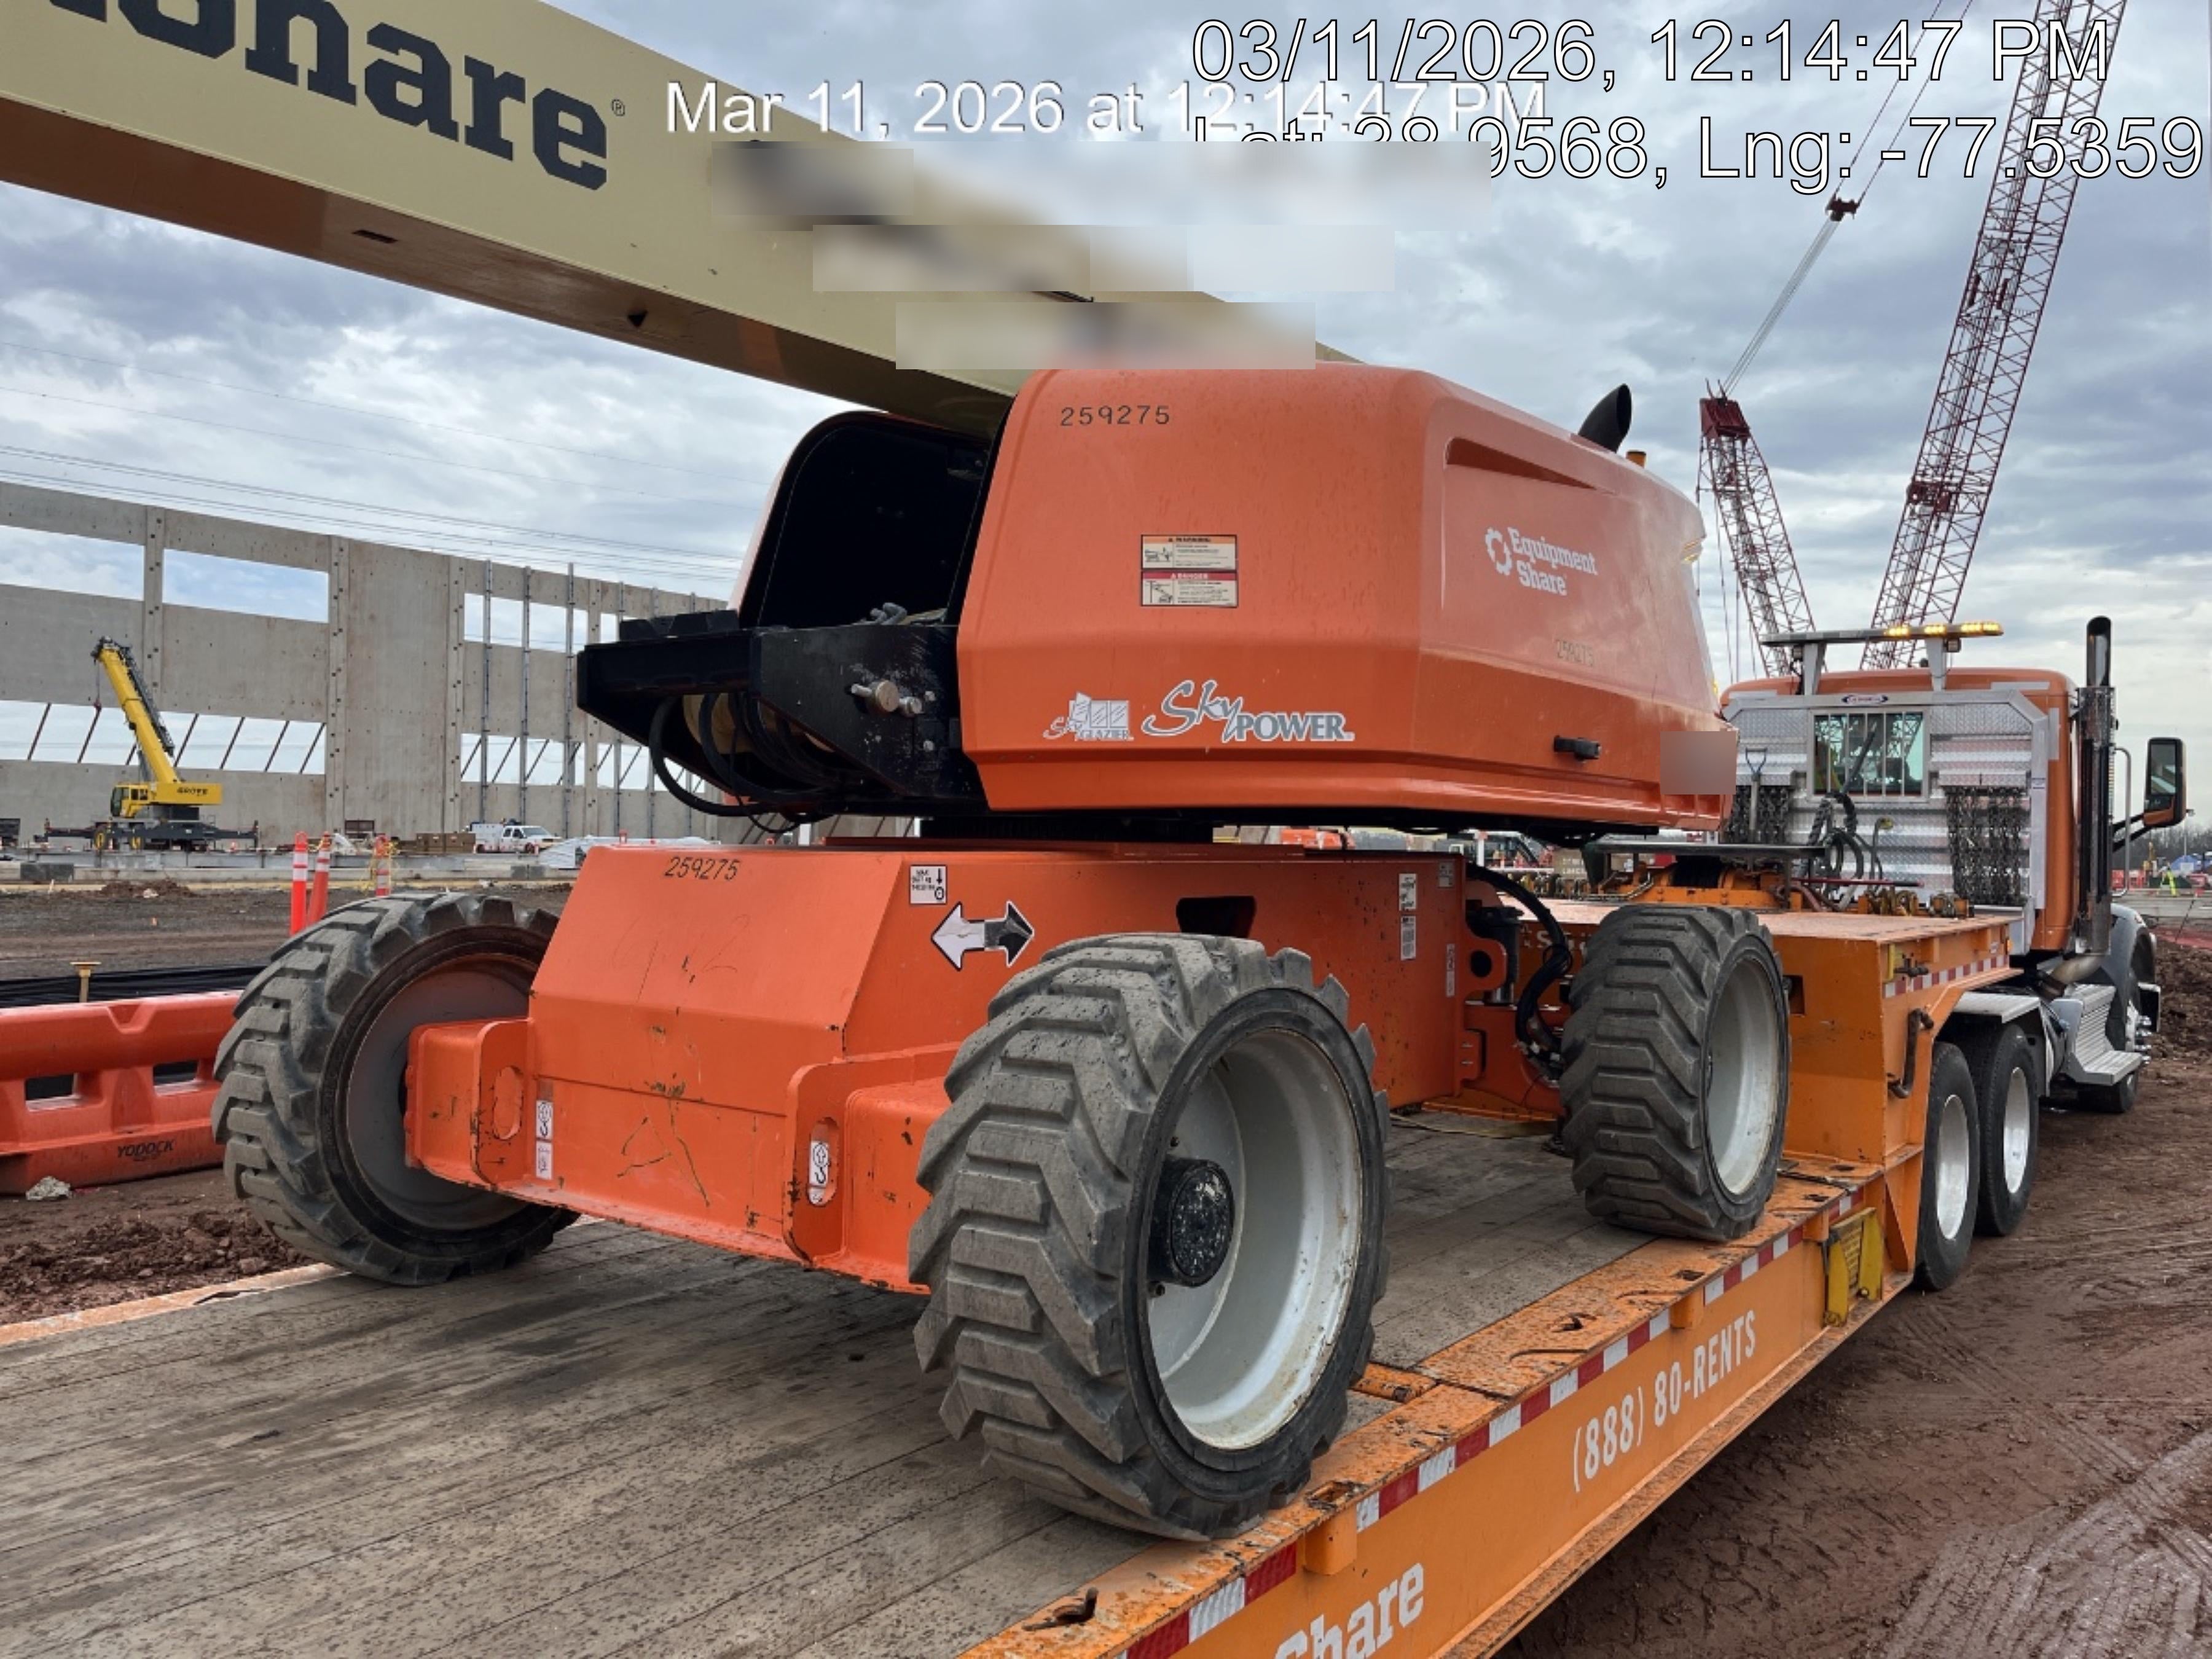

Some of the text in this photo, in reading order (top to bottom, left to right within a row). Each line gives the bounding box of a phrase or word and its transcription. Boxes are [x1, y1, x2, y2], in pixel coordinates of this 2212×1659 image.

[1060, 404, 1171, 426] 259275
[1507, 526, 1598, 576] Equipment
[1516, 559, 1567, 596] Share
[1140, 678, 1347, 744] Sky POWER
[664, 856, 742, 880] 259275
[117, 1140, 176, 1158] YODOCK
[1574, 1309, 1756, 1493] (888) 80-RENTS
